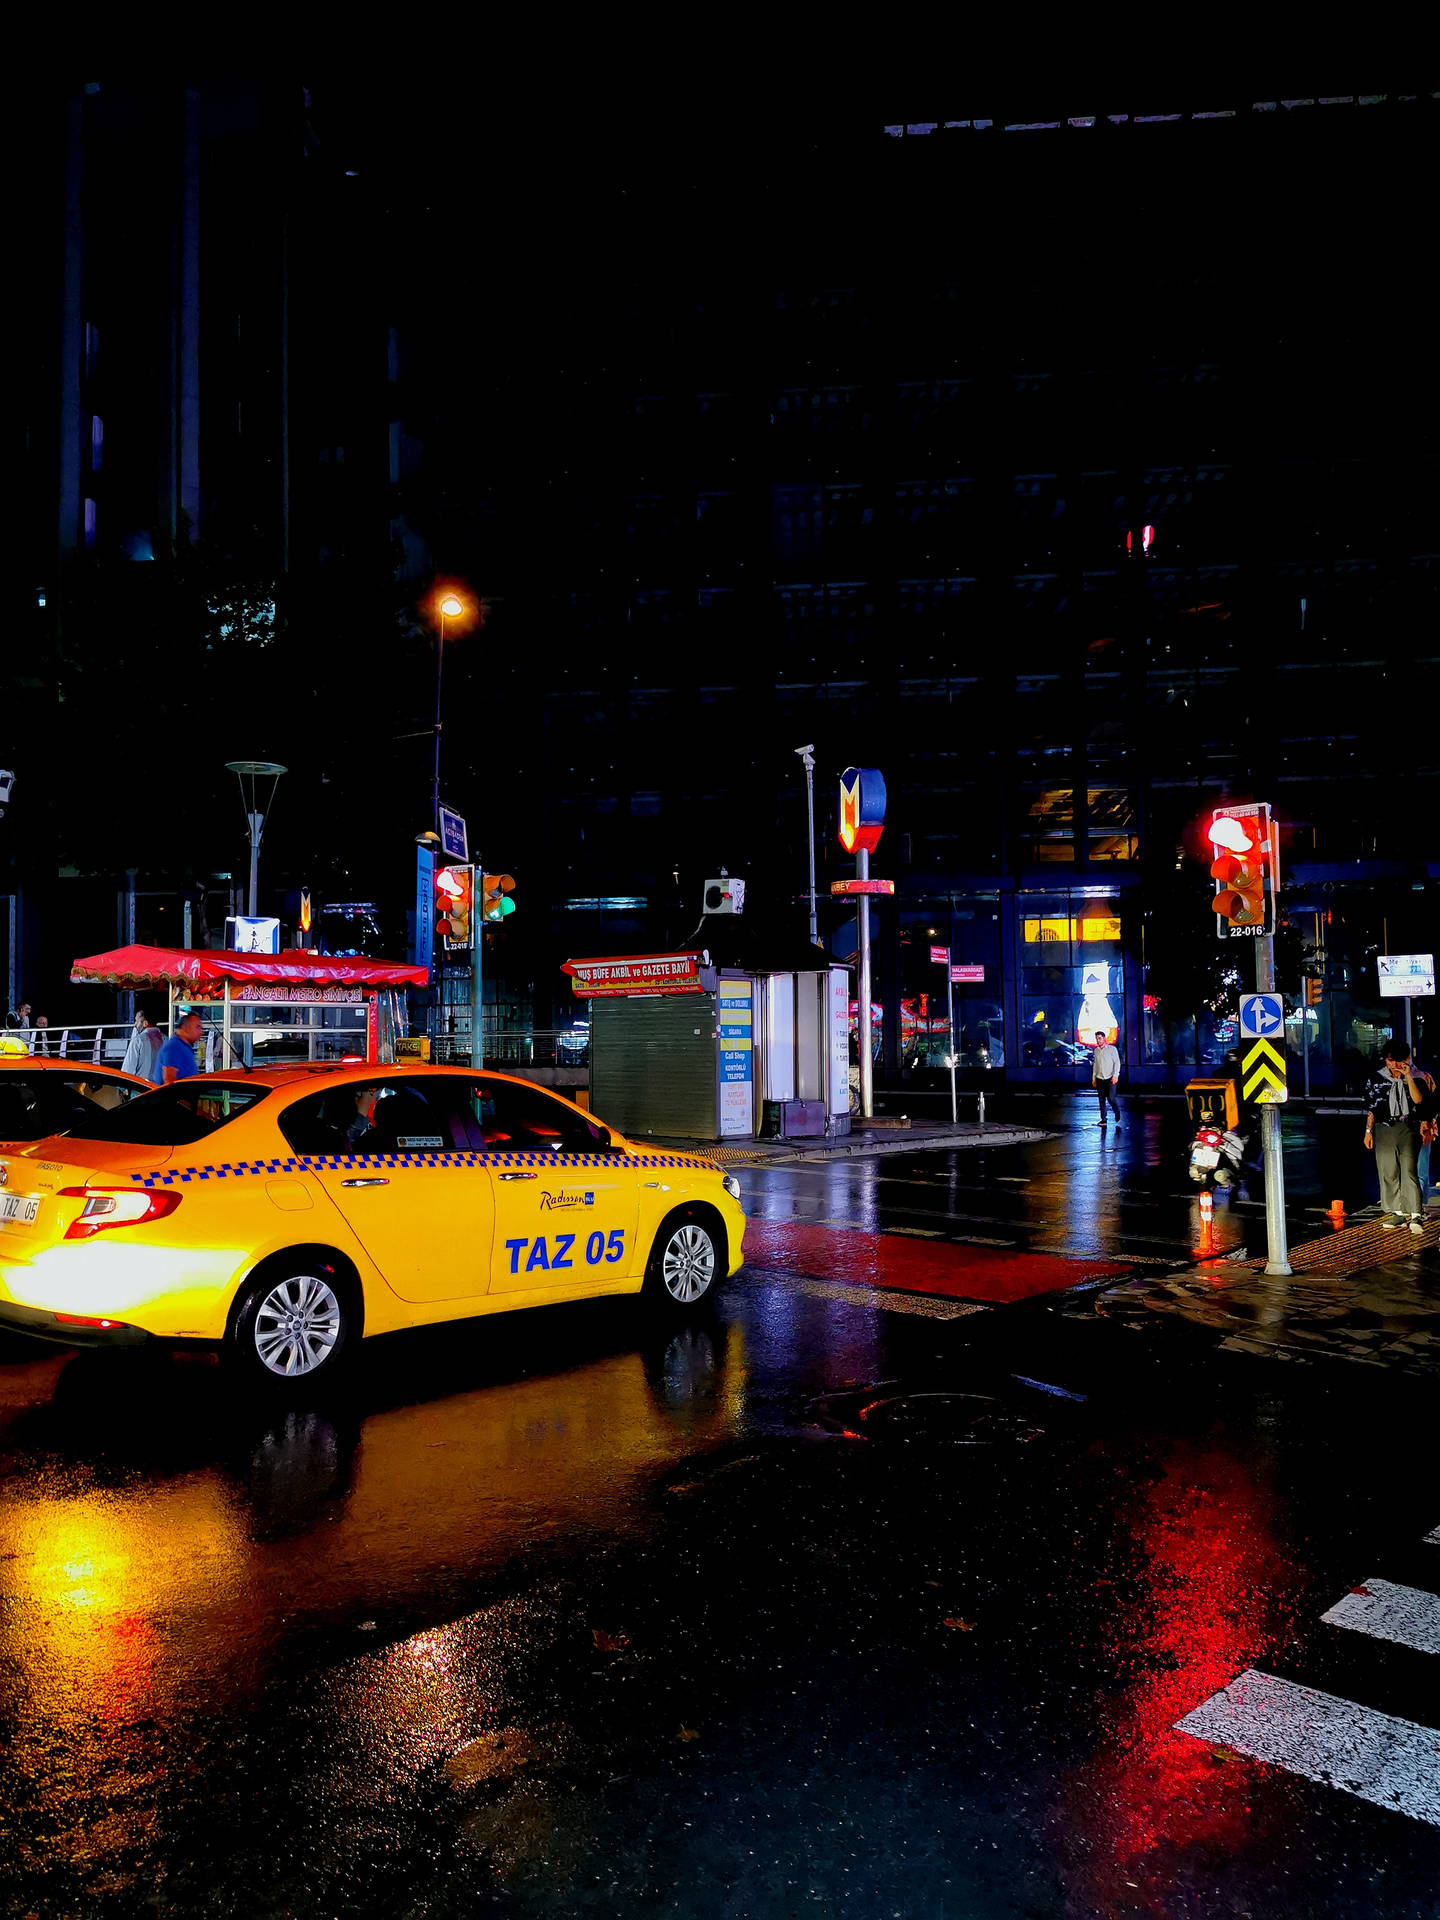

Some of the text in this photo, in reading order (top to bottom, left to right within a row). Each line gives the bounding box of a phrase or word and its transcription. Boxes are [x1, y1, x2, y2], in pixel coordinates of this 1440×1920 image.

[1230, 926, 1263, 937] 22-016
[592, 967, 609, 979] BÜFE
[611, 965, 631, 979] AKBİL
[632, 968, 641, 977] ve
[642, 963, 670, 976] GAZETE
[242, 986, 288, 1001] PANGALTI
[289, 987, 322, 1001] METRO
[3, 1197, 38, 1221] TAZ 05
[540, 1189, 585, 1211] Radisson
[505, 1229, 625, 1274] TAZ 05
